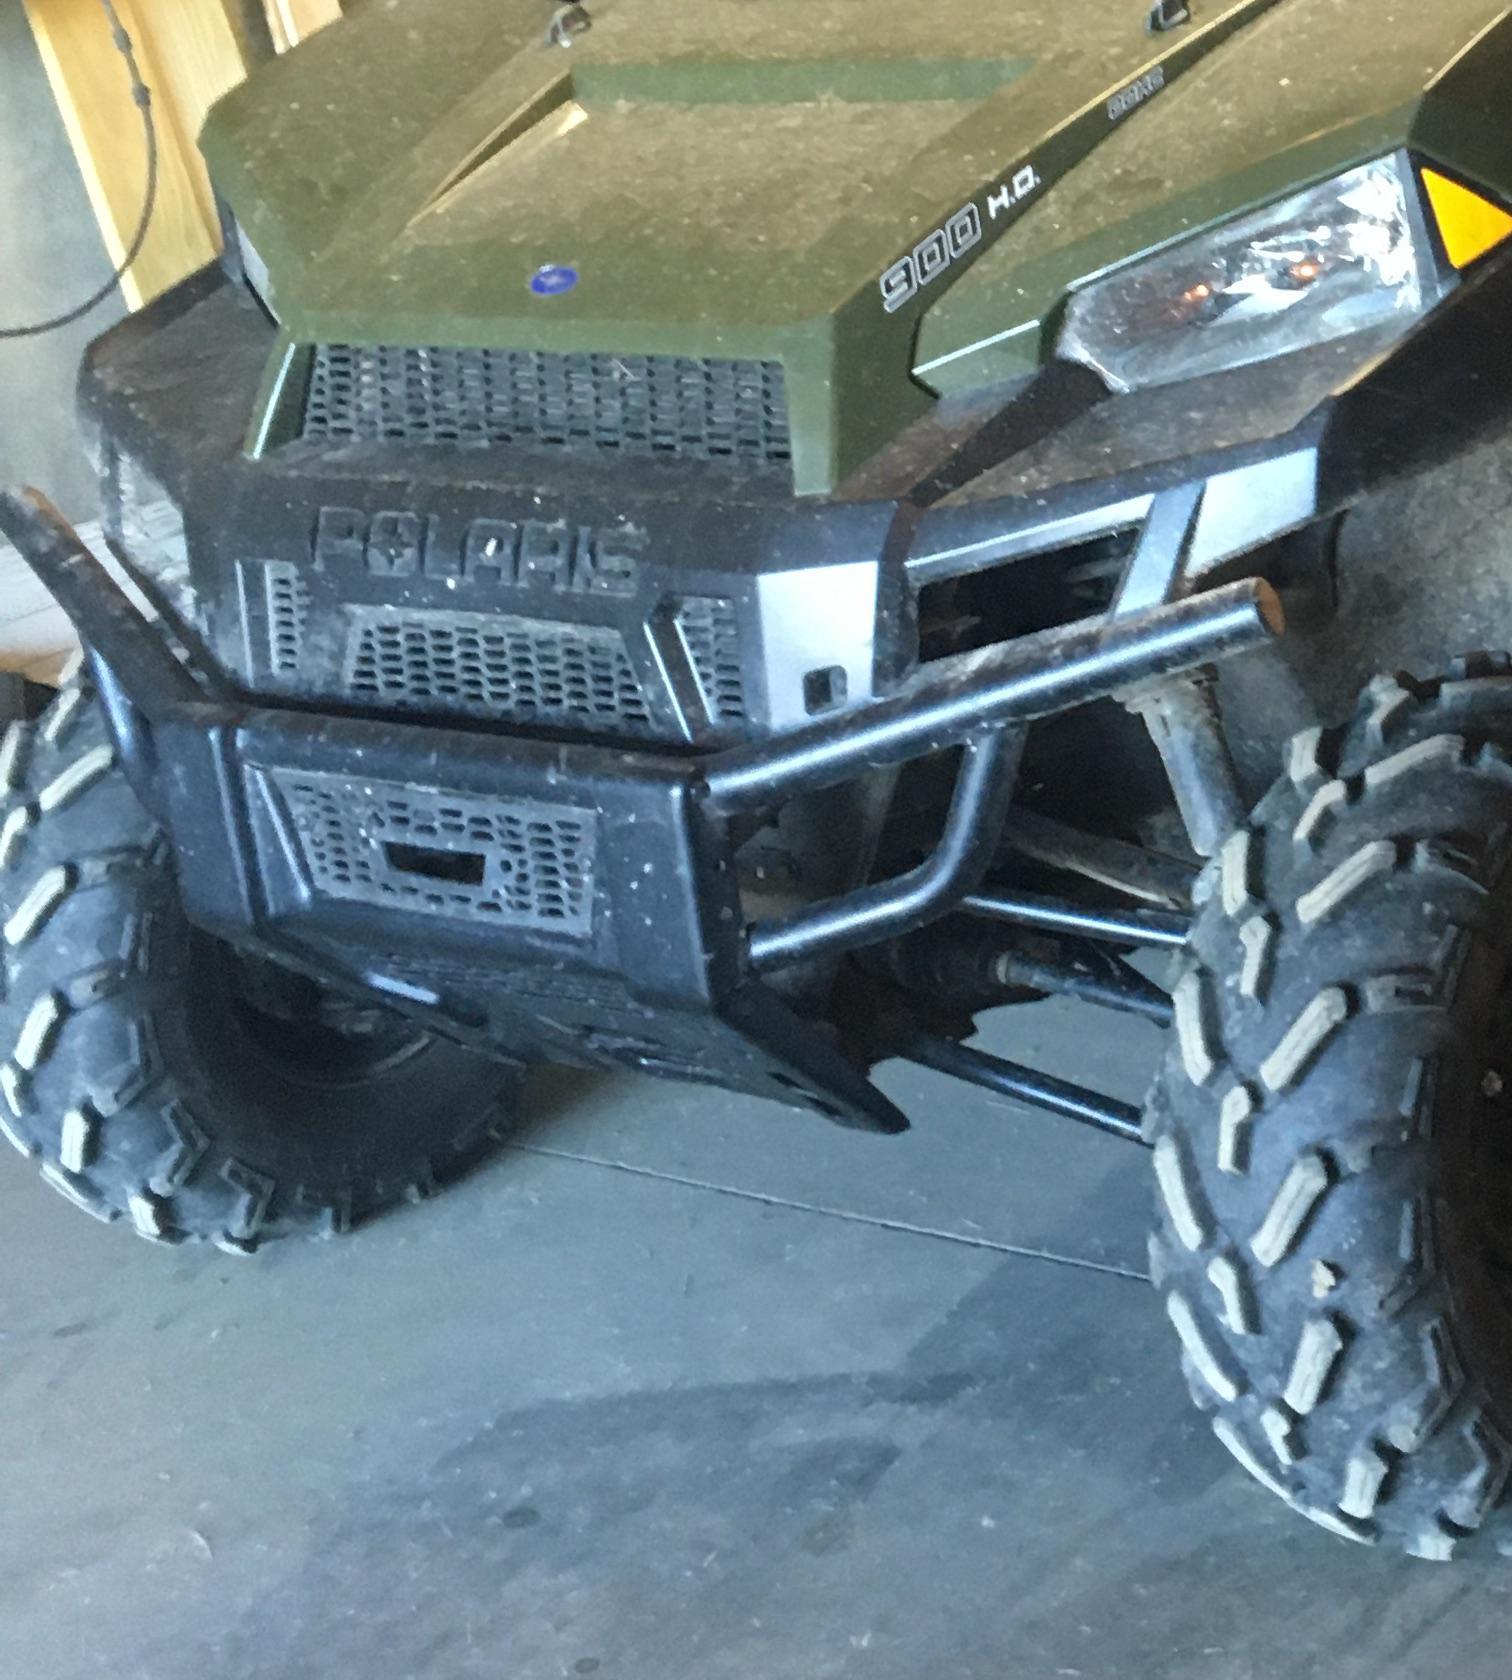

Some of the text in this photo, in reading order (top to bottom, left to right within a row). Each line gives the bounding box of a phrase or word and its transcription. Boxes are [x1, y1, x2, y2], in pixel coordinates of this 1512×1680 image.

[880, 165, 1041, 313] 900 H.O.
[311, 506, 650, 597] POLARIS
